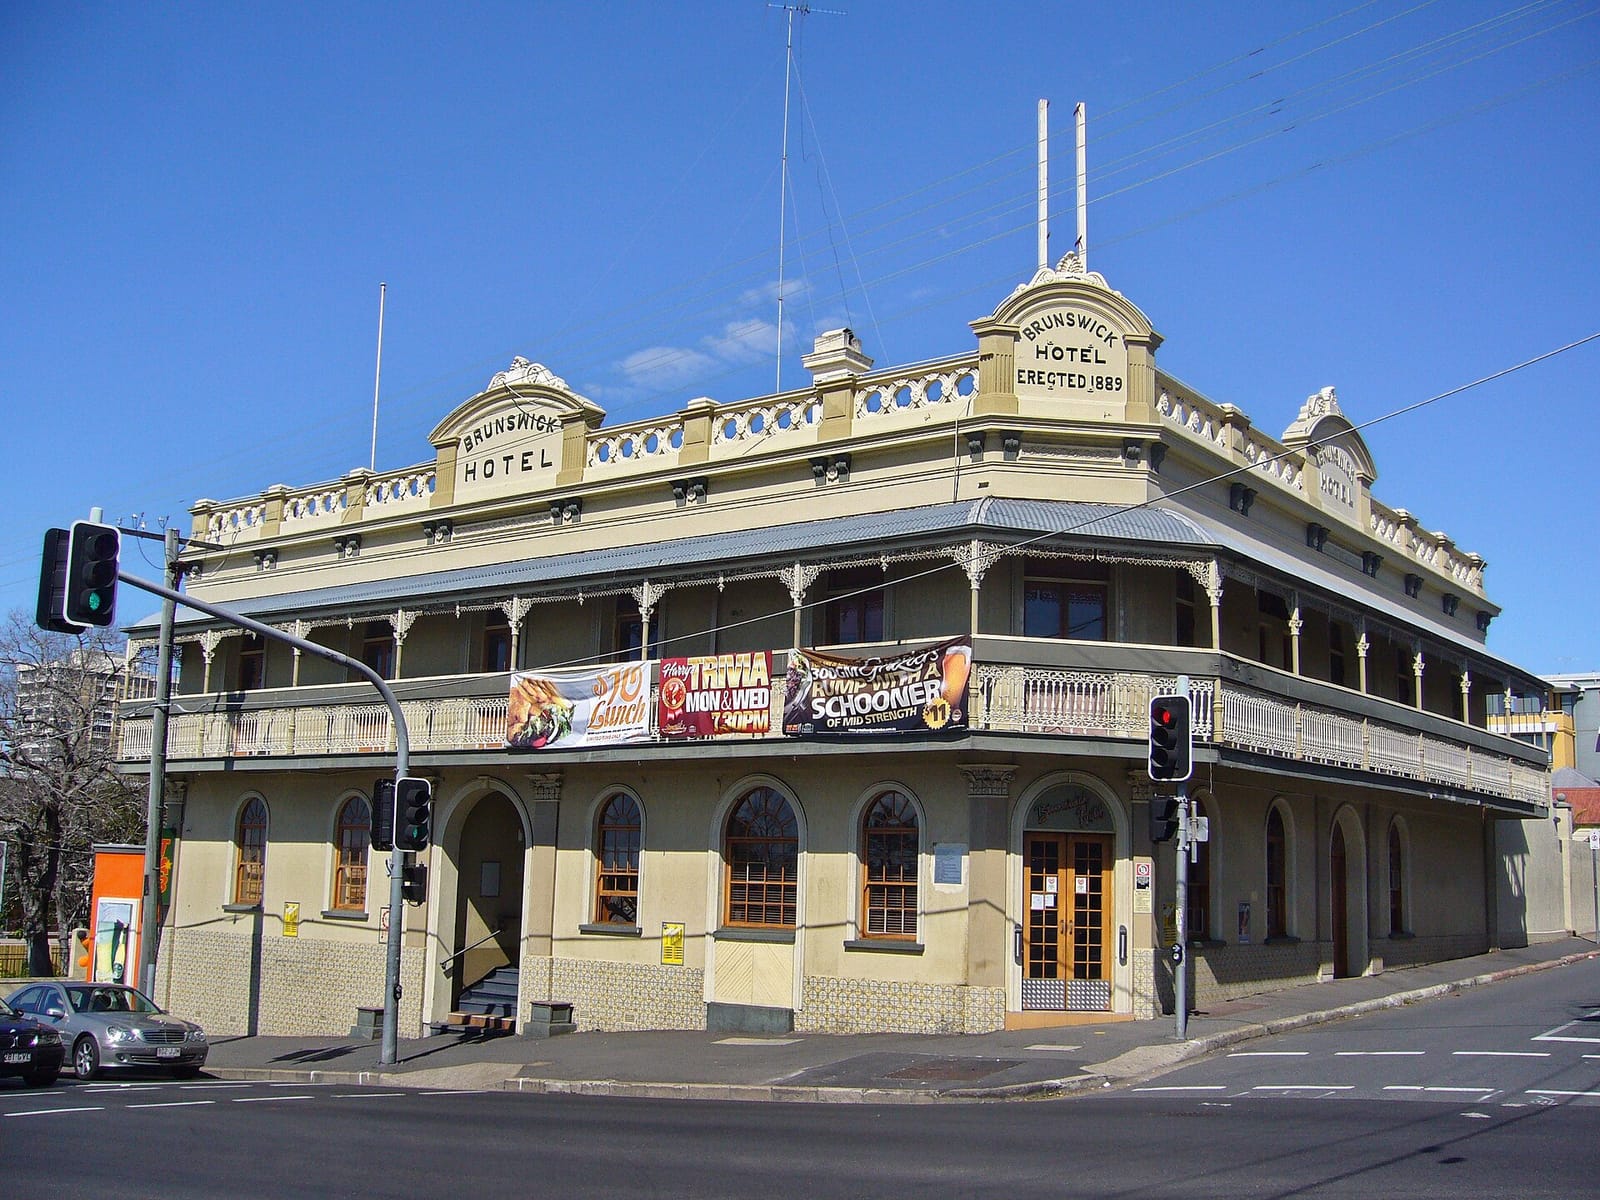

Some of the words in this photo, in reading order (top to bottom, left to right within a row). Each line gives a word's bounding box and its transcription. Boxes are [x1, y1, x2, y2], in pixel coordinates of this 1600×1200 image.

[1022, 312, 1118, 348] BRUNSWICK
[1036, 344, 1107, 365] HOTEL
[1017, 368, 1086, 389] ERECTED
[1090, 375, 1123, 392] 1889
[463, 413, 560, 454] BRUNSWICK
[464, 448, 553, 483] HOTEL
[593, 666, 643, 706] $10
[687, 651, 769, 690] TRIVIA
[811, 665, 860, 681] 300GM
[812, 678, 868, 698] RUMP
[872, 669, 922, 691] WITH
[923, 662, 942, 680] A
[587, 695, 646, 730] Lunch
[685, 690, 721, 713] MON
[732, 688, 769, 710] WED
[811, 679, 941, 720] SCHOONER
[826, 717, 842, 728] OF
[842, 715, 864, 727] MID
[864, 705, 918, 725] STRENGTH
